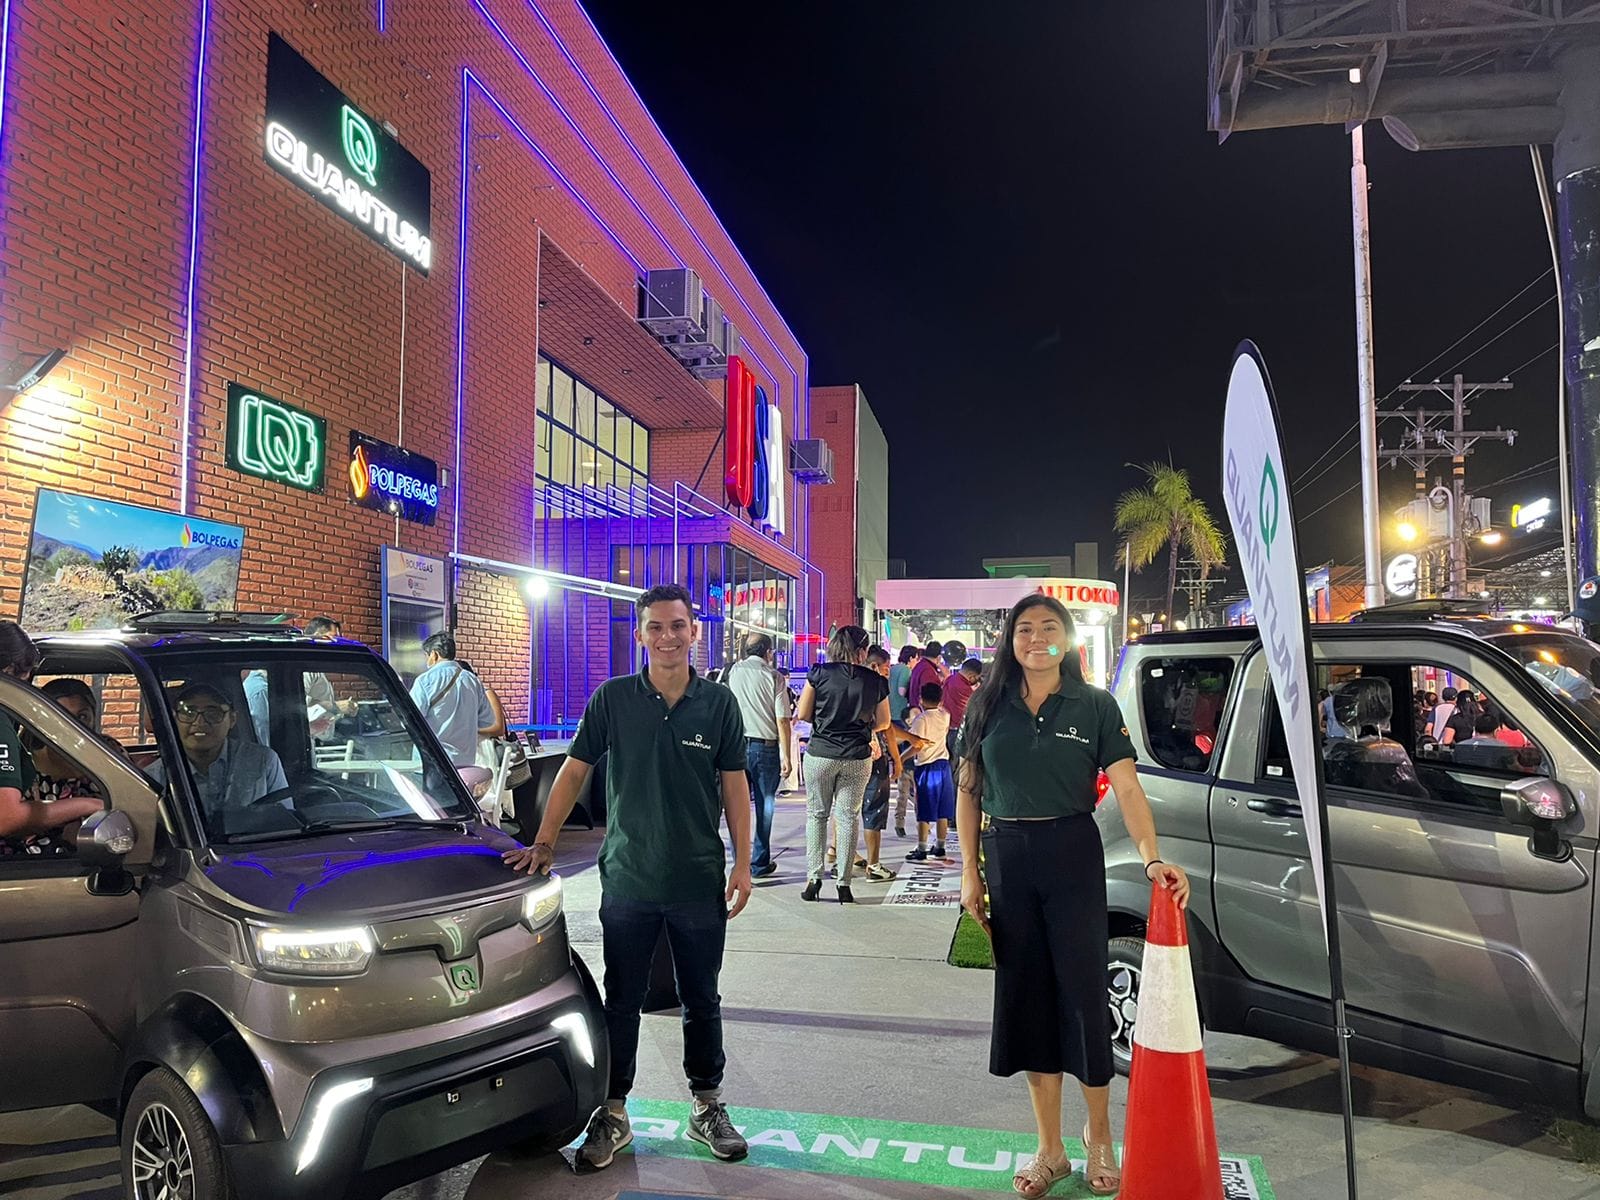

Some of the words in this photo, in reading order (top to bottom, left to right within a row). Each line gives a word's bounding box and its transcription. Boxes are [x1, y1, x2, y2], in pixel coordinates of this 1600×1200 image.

[266, 121, 432, 269] QUANTUM
[369, 464, 437, 507] BOLPEGAS
[192, 530, 239, 550] BOLPEGAS
[1227, 448, 1299, 720] QUANTUM
[681, 739, 711, 750] QUANTUM
[1055, 732, 1090, 743] QUANTUM
